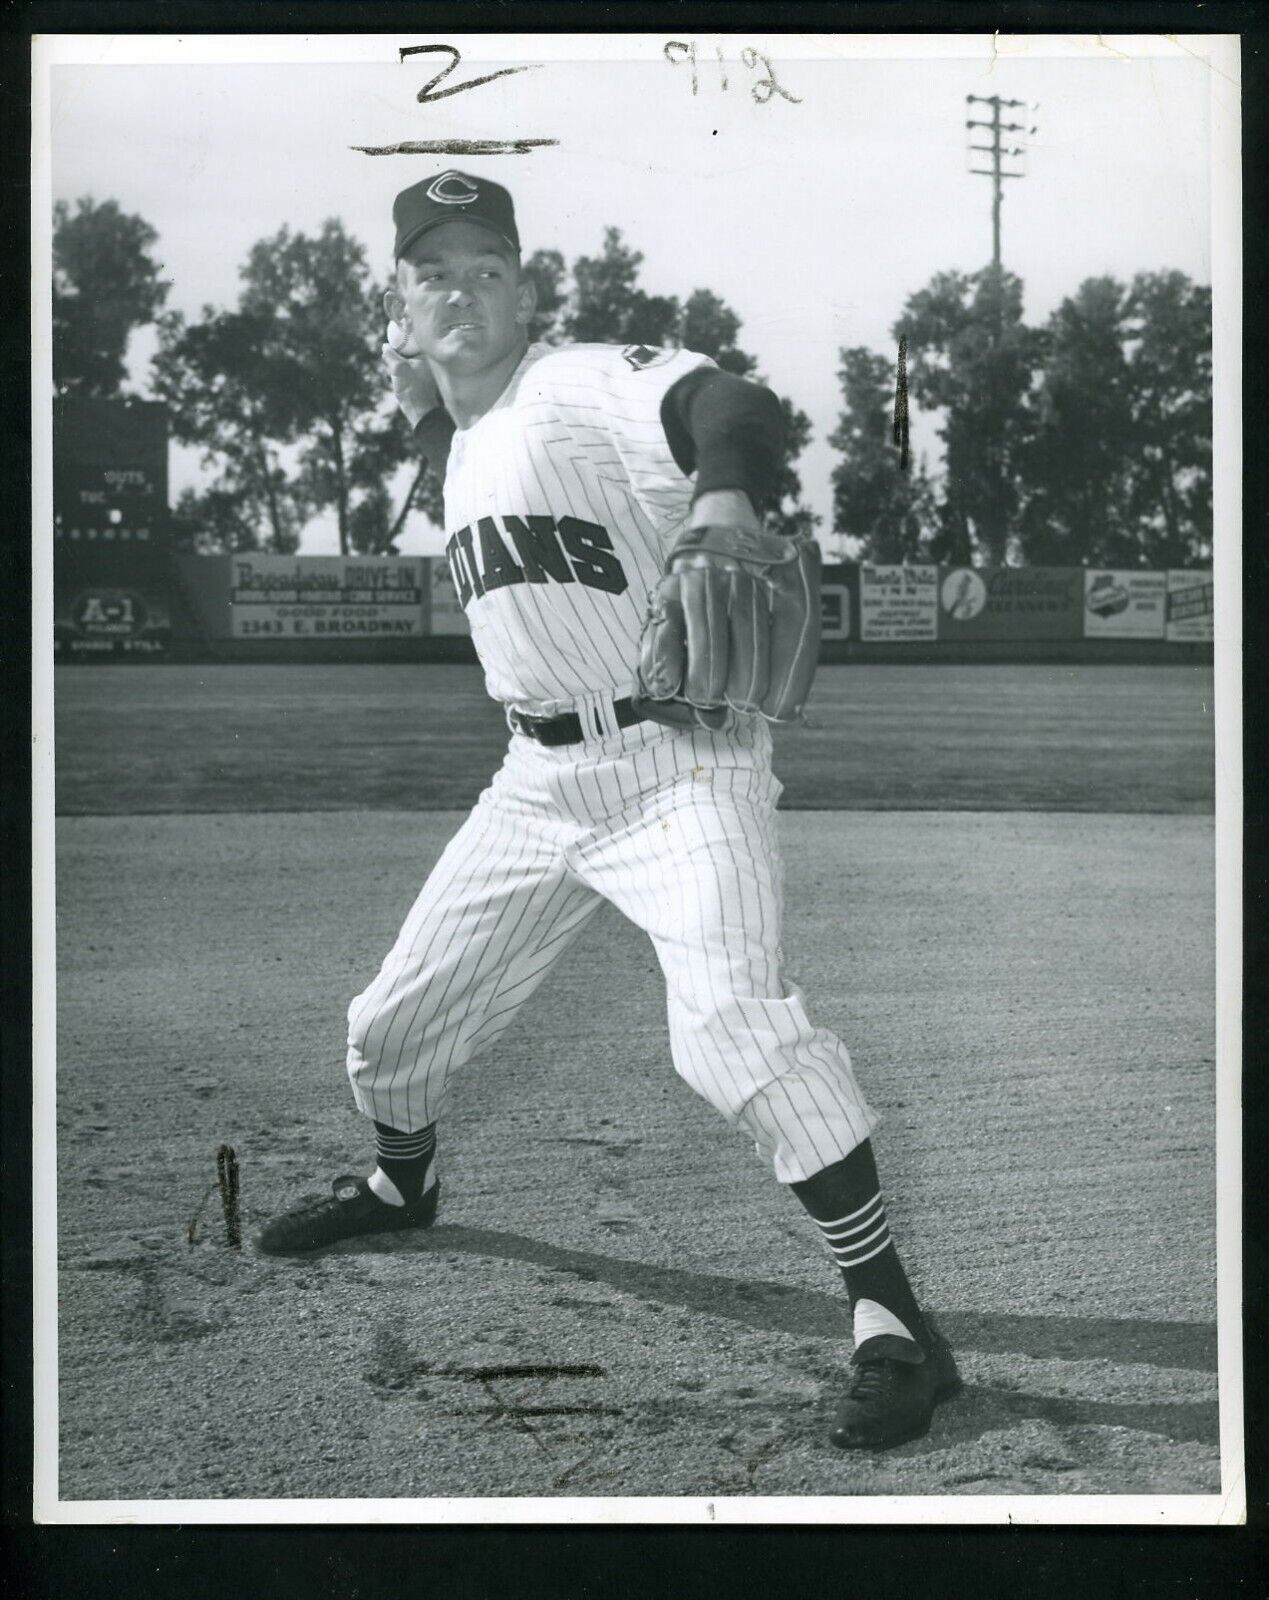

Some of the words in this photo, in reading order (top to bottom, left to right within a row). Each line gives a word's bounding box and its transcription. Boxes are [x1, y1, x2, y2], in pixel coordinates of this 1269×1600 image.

[427, 171, 479, 205] C
[446, 515, 629, 609] DIANS
[345, 565, 416, 589] DRIVE-IN
[80, 598, 135, 622] A-1
[314, 620, 416, 633] BROADWAY
